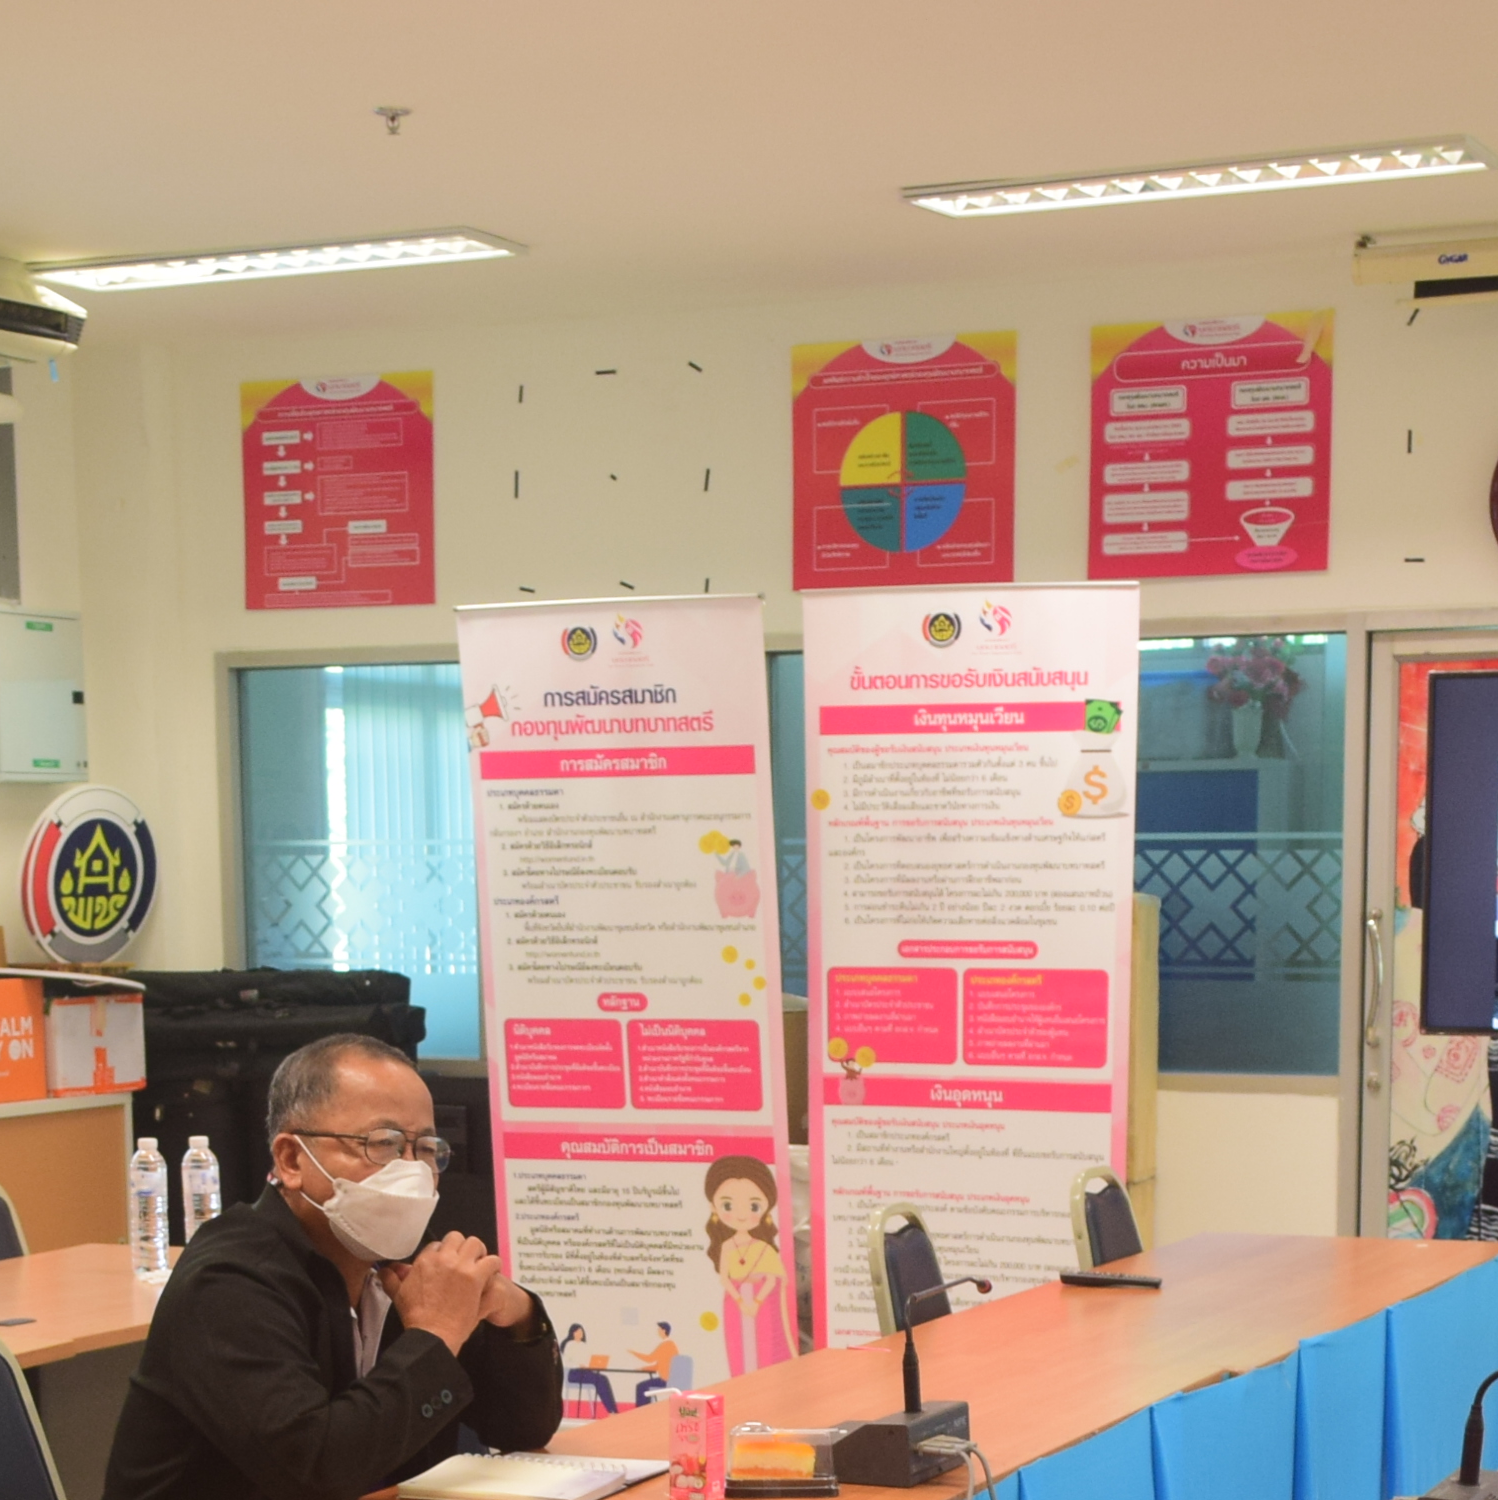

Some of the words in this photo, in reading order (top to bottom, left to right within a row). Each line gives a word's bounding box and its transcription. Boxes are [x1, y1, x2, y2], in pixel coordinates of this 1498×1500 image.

[1181, 352, 1247, 370] ความเป็นมา
[850, 666, 1089, 692] ขั้นตอนการขอรับเงินสนับสนุน
[543, 684, 677, 708] การสมัครสมาชิก
[511, 710, 714, 741] กองทุนพัฒนาบทบาทสตรี
[914, 707, 1025, 731] เงินทุนหมุนเวียน
[560, 752, 667, 772] การสมัครสมาชิก
[602, 994, 641, 1010] หลักฐาน
[930, 1084, 1003, 1109] เงินอุดหนุน
[561, 1138, 715, 1160] คุณสมบัติการเป็นสมาชิก
